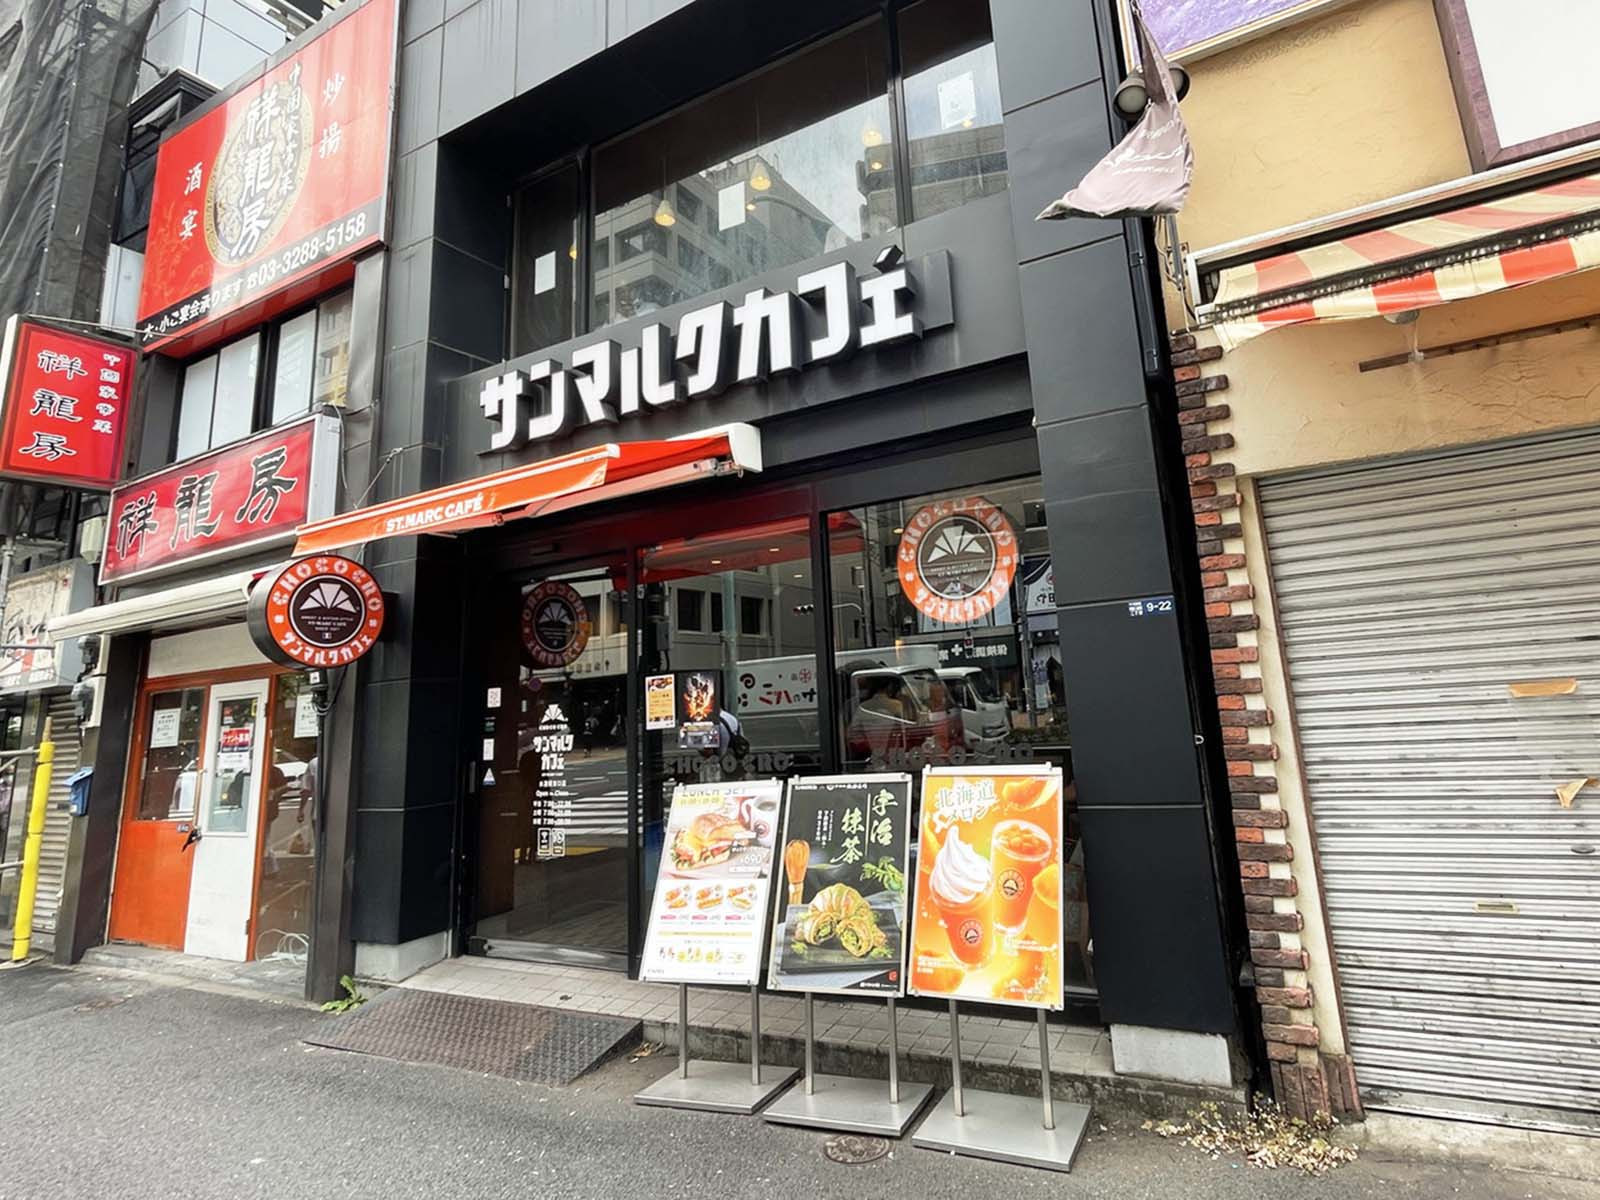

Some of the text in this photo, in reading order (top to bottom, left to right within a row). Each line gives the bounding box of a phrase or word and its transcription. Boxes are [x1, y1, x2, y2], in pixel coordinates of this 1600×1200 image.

[231, 84, 281, 257] 祥龍房
[258, 211, 366, 284] 03-3288-5158
[479, 246, 918, 450] サンマルクカフェ
[18, 349, 88, 461] 祥龍房
[116, 447, 299, 561] 祥龍房
[386, 492, 484, 533] ST.MARC CAFÉ
[272, 557, 382, 612] CHOCO CRO
[1146, 600, 1172, 612] 9-22
[280, 631, 373, 665] サンマルクカフェ
[533, 734, 574, 753] サンマルク
[541, 753, 565, 771] カフェ
